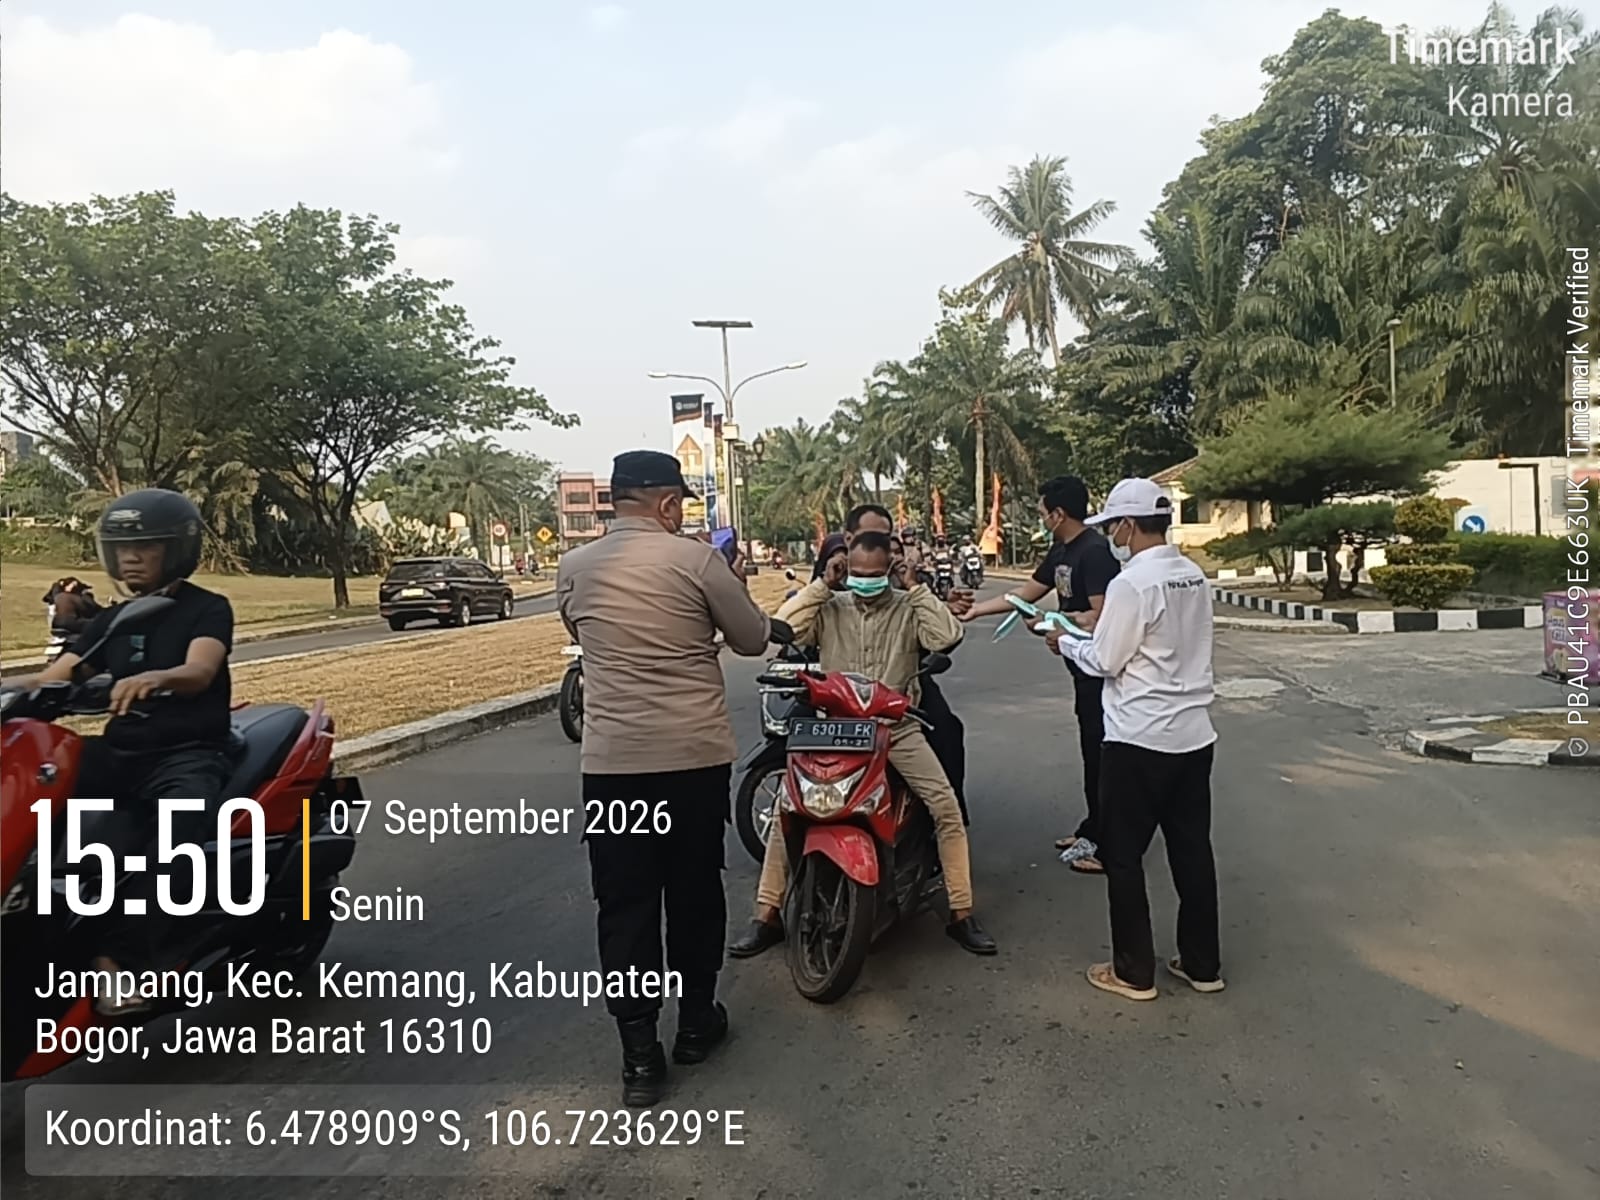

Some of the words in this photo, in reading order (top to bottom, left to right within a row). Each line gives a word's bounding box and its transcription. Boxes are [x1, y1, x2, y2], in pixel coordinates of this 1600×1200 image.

[794, 723, 803, 736] F
[812, 724, 842, 736] 6301
[854, 723, 872, 737] FK
